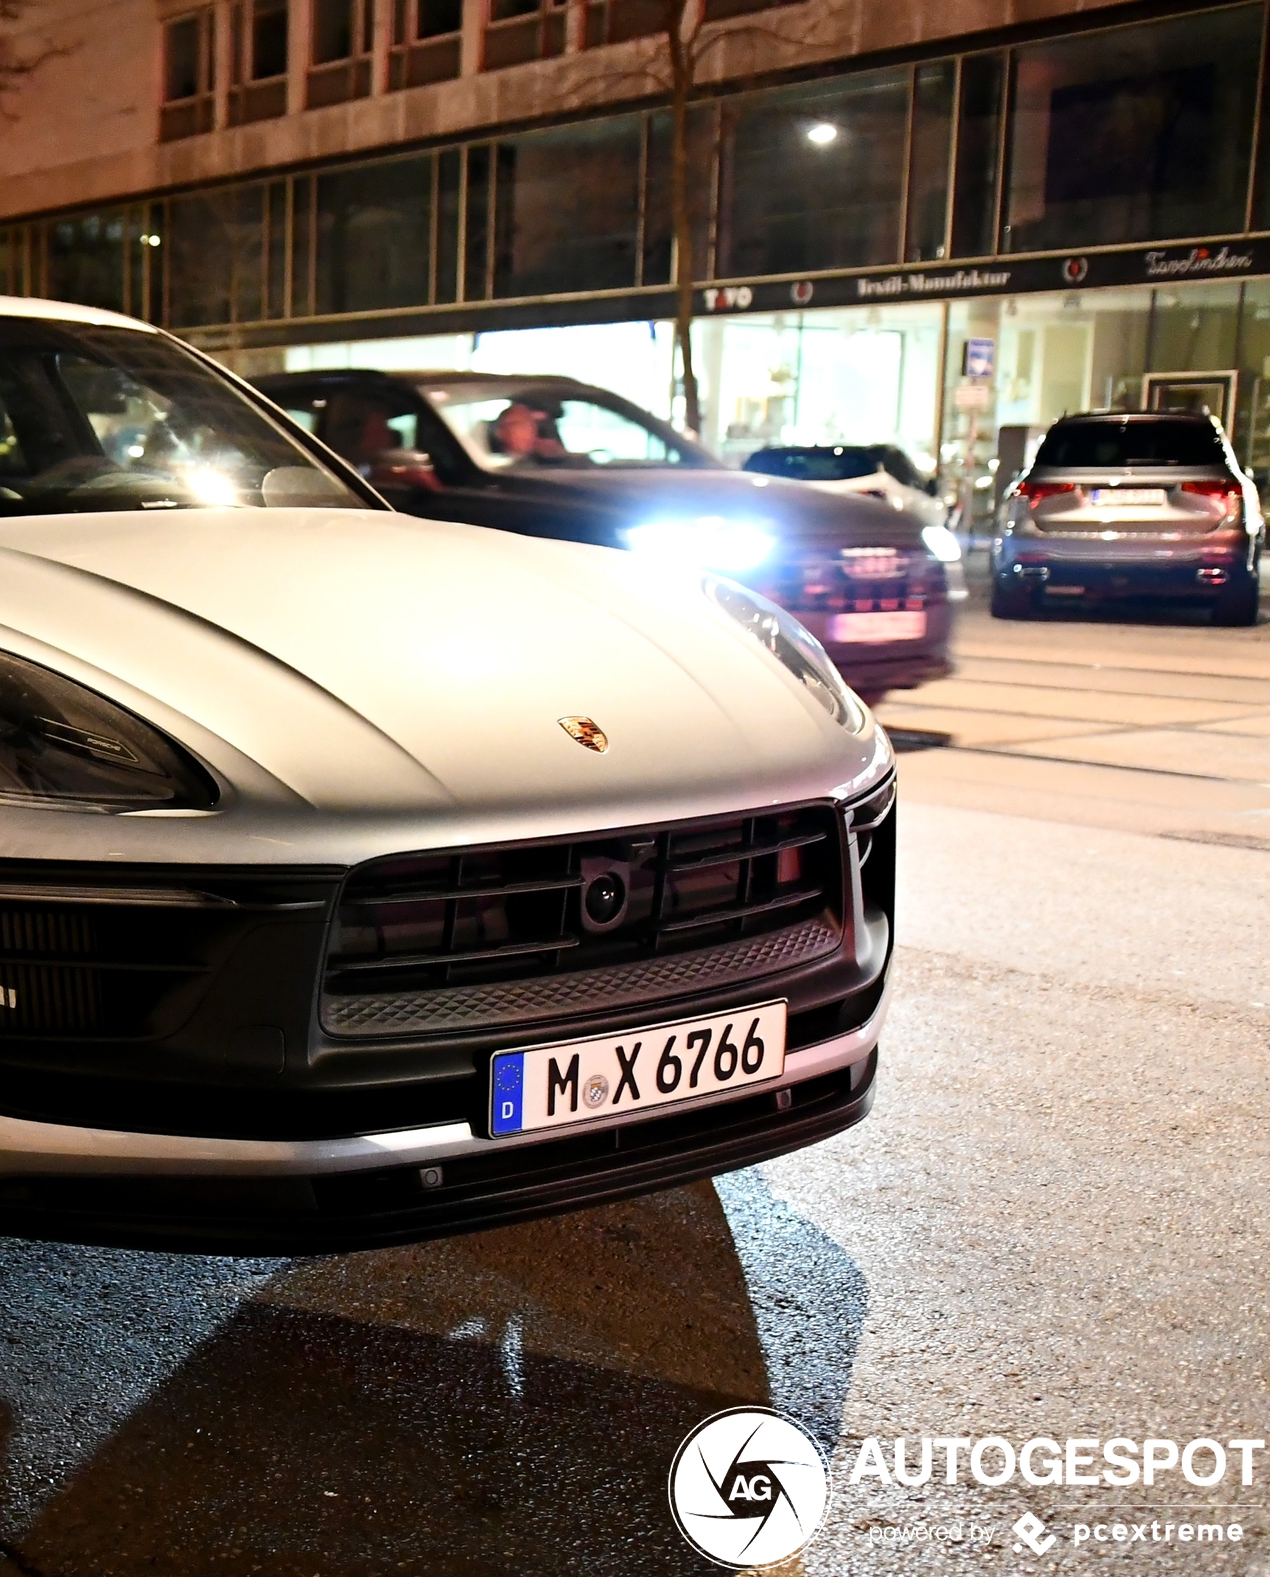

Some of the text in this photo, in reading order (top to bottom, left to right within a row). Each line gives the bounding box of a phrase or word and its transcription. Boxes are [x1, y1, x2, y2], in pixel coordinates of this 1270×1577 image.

[858, 269, 1011, 297] Textil-Manufaktur
[703, 286, 753, 312] TAVO
[501, 1101, 514, 1119] D
[547, 1053, 580, 1117] M
[656, 1017, 765, 1094] 6766
